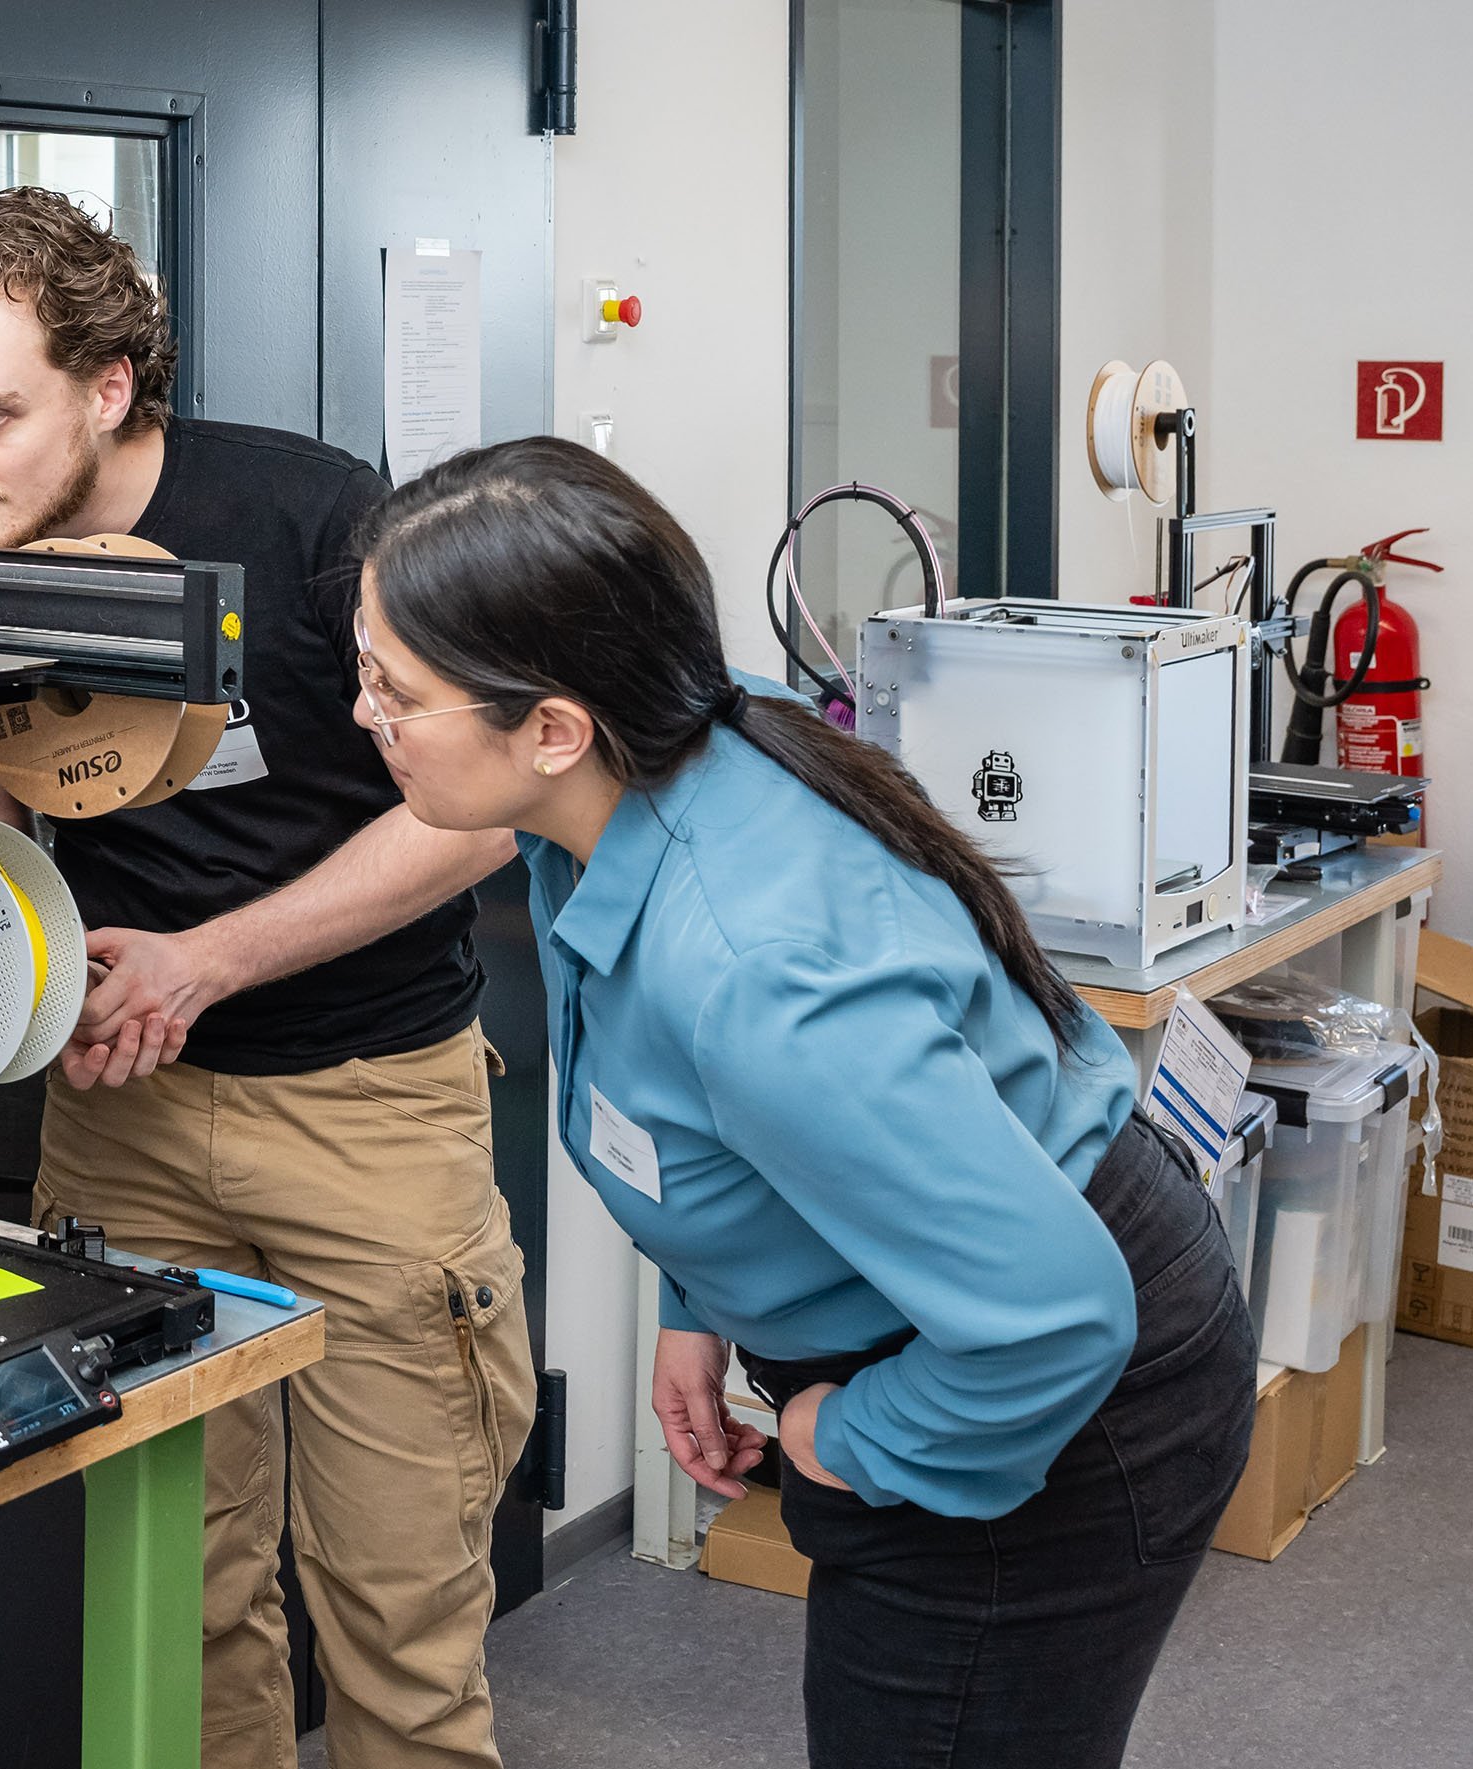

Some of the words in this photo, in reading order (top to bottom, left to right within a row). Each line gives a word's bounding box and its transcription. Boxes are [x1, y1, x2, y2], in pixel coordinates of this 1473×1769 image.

[51, 741, 80, 759] FILAMENT
[80, 733, 106, 749] PRINTER
[57, 750, 123, 789] eSUN
